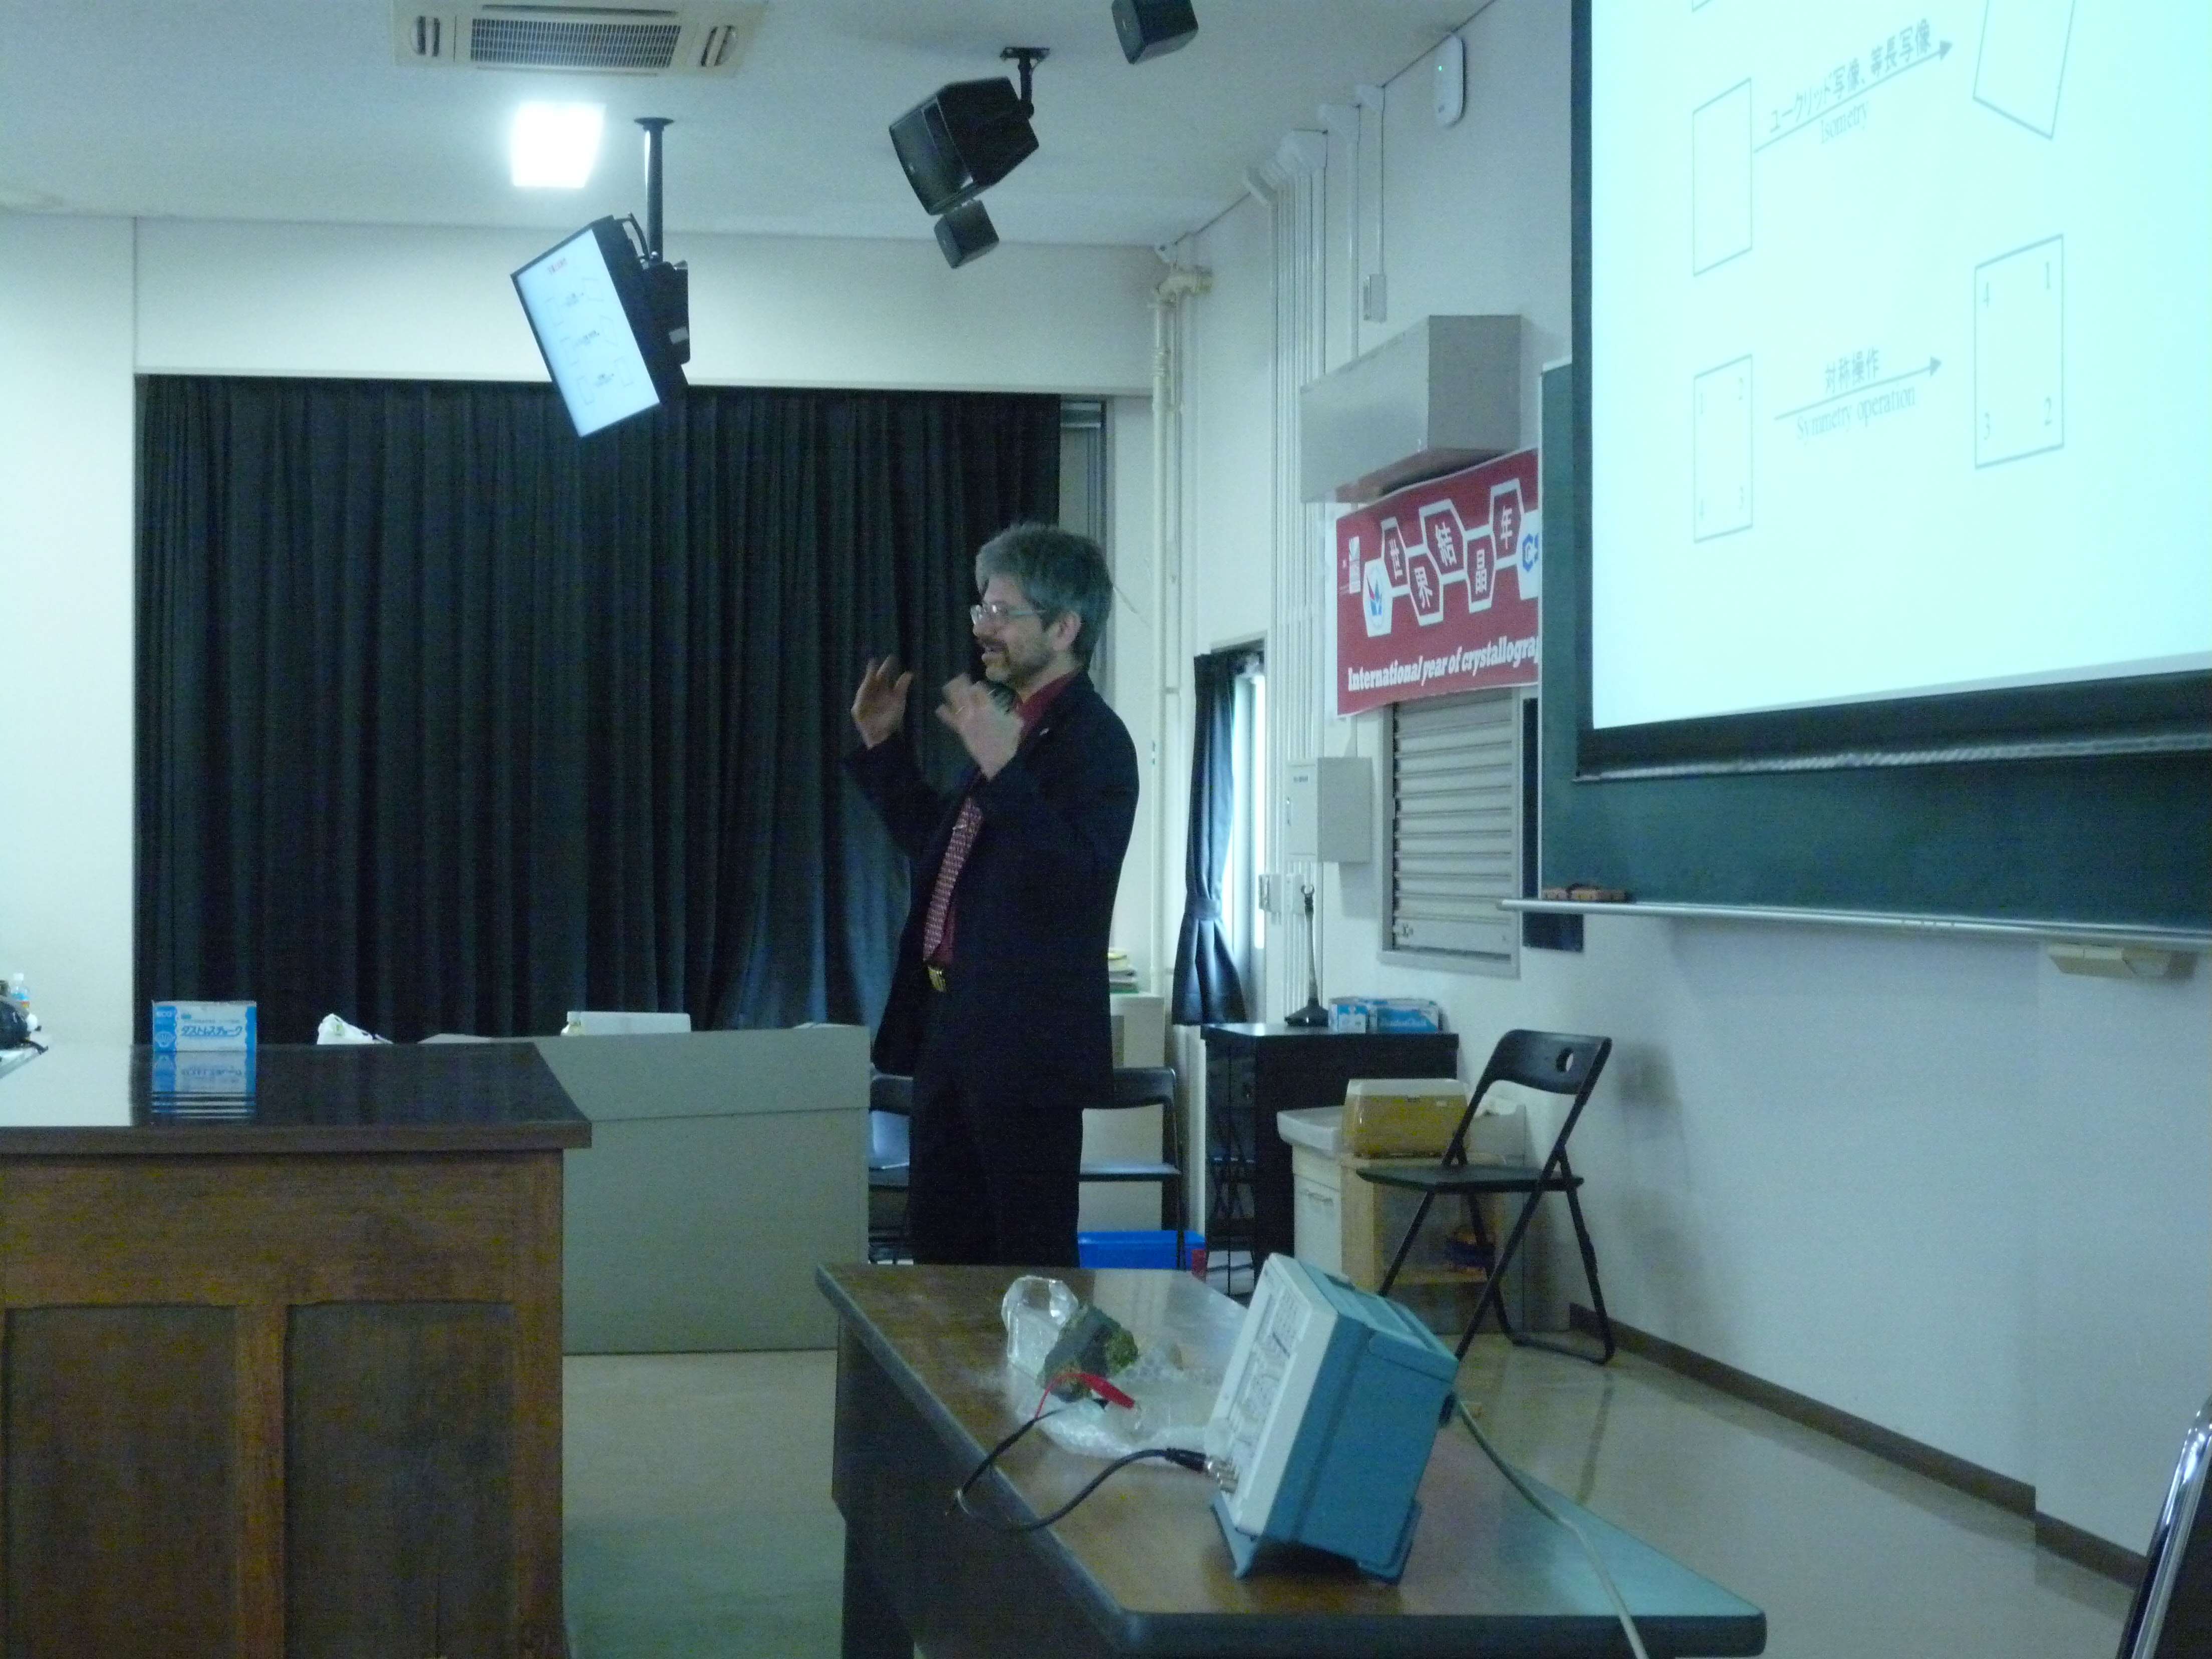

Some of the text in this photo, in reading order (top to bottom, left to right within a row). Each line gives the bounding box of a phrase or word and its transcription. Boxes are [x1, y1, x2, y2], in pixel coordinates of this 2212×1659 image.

[1820, 100, 1869, 144] Isometry
[2045, 261, 2051, 291] 1
[1824, 345, 1879, 394] 対称操作
[1797, 385, 1915, 446] Symmetry operation
[1983, 411, 1991, 441] 3
[2044, 396, 2053, 427] 2
[1348, 655, 1423, 691] International
[1421, 656, 1449, 686] year
[1448, 645, 1463, 674] of
